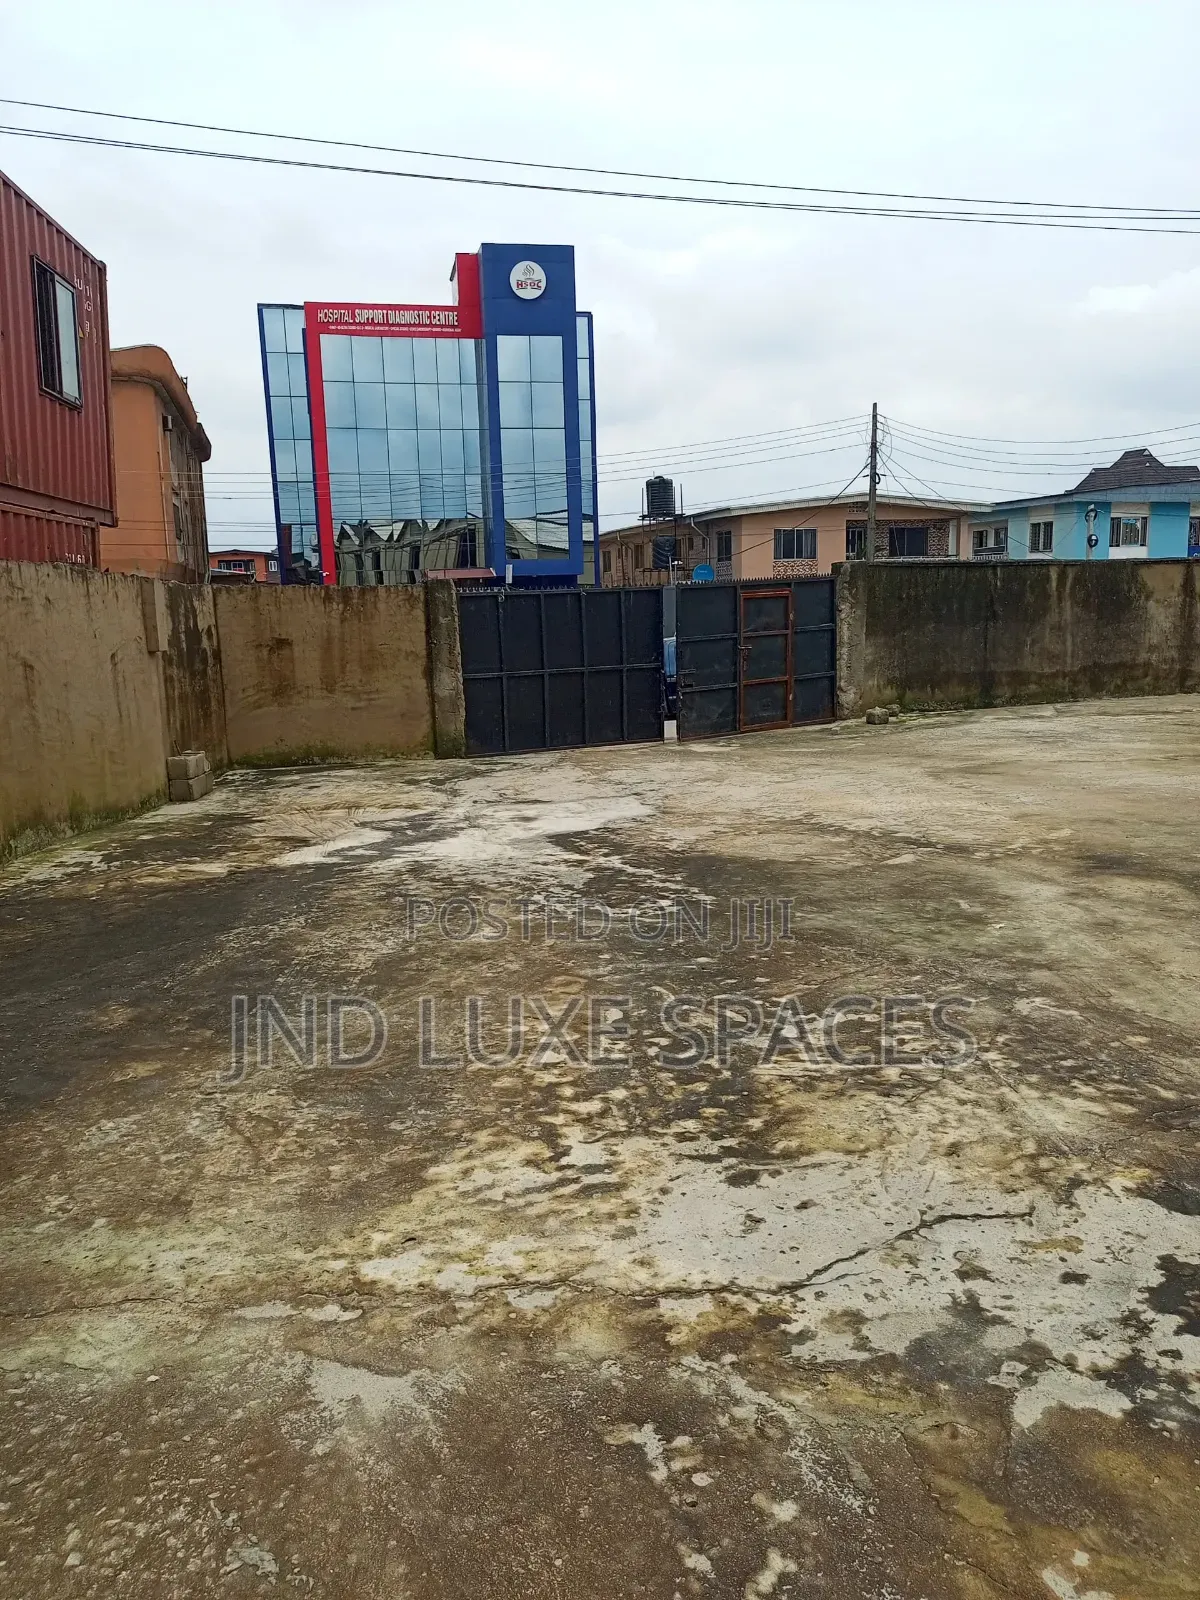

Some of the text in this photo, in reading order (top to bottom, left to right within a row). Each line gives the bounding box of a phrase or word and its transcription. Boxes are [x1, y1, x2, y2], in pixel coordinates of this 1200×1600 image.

[317, 309, 458, 325] HOSPITAL SUPPORT DIAGNOSTIC CENTRE
